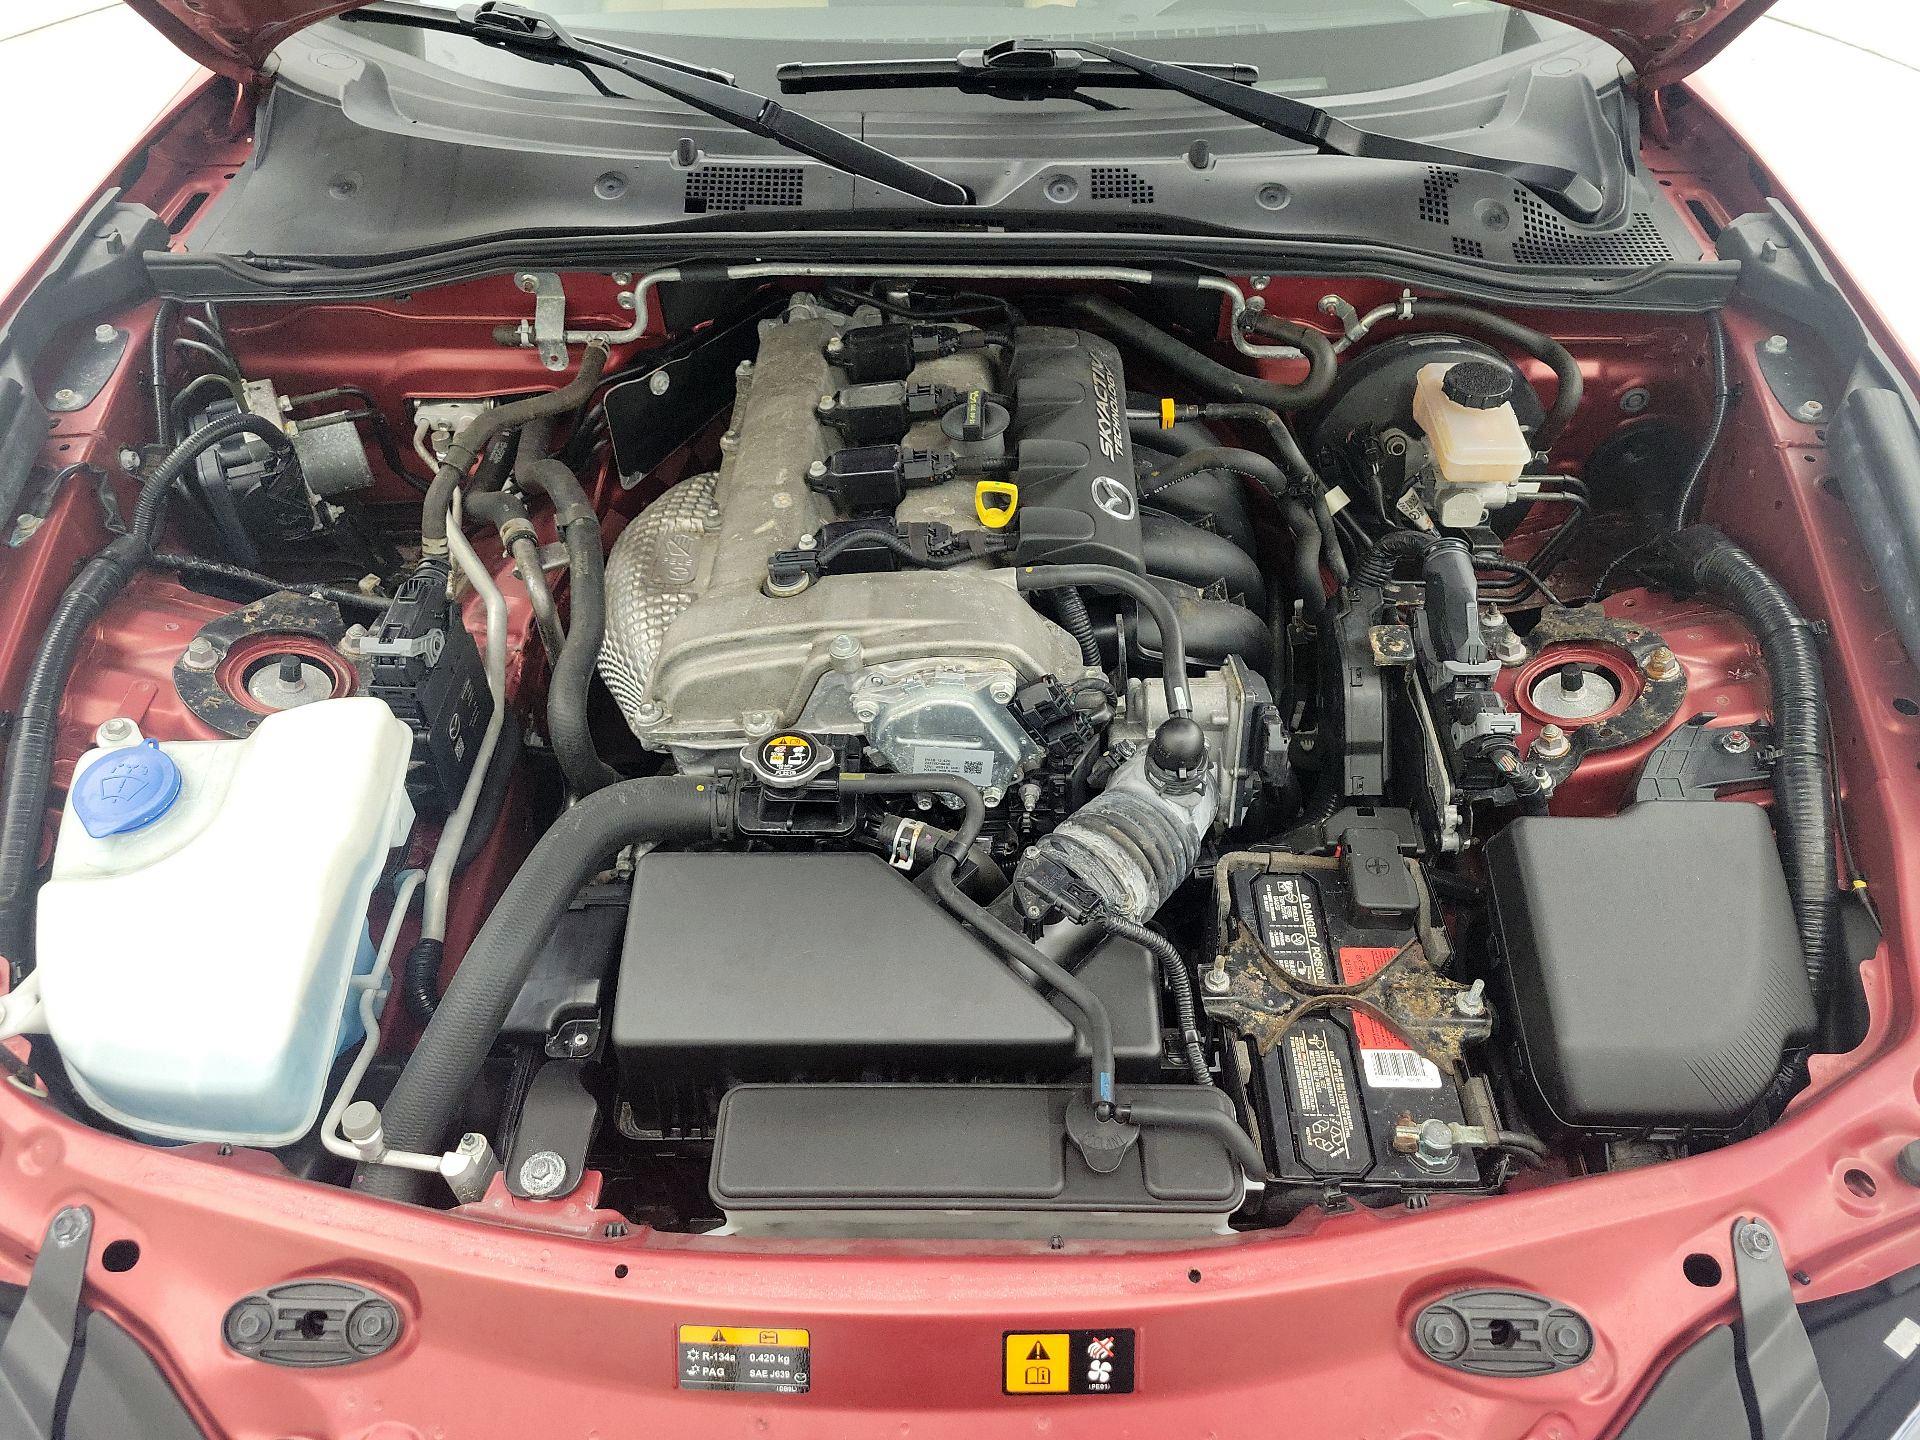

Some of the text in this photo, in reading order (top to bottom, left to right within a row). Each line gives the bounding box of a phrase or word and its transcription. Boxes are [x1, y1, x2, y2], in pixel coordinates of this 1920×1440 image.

[1089, 352, 1115, 463] SKYACTIV
[1104, 364, 1124, 457] TECHNOLOGY
[1303, 903, 1317, 938] DANGER
[1311, 947, 1326, 979] POISON
[702, 1351, 790, 1365] R-134a 0.420 kg
[702, 1367, 790, 1378] PAG SAE J639
